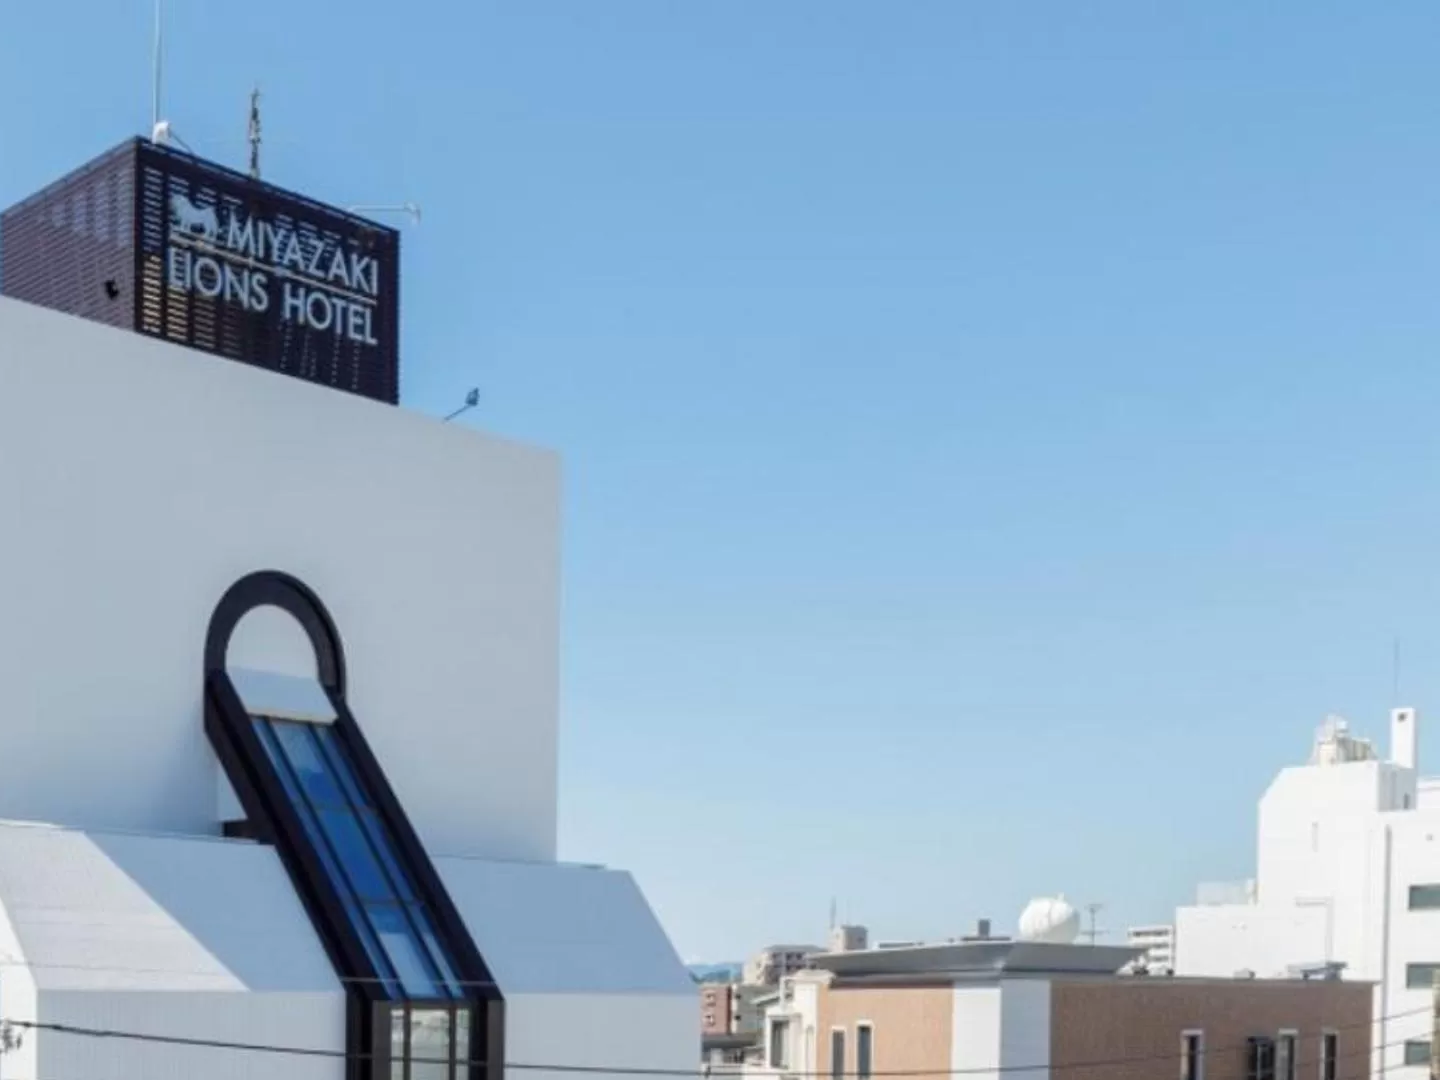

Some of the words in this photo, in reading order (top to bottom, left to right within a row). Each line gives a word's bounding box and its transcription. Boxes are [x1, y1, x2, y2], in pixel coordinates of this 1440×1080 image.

[168, 248, 268, 312] LIONS
[283, 283, 378, 345] HOTEL
[228, 212, 378, 296] MIYAZAKI
